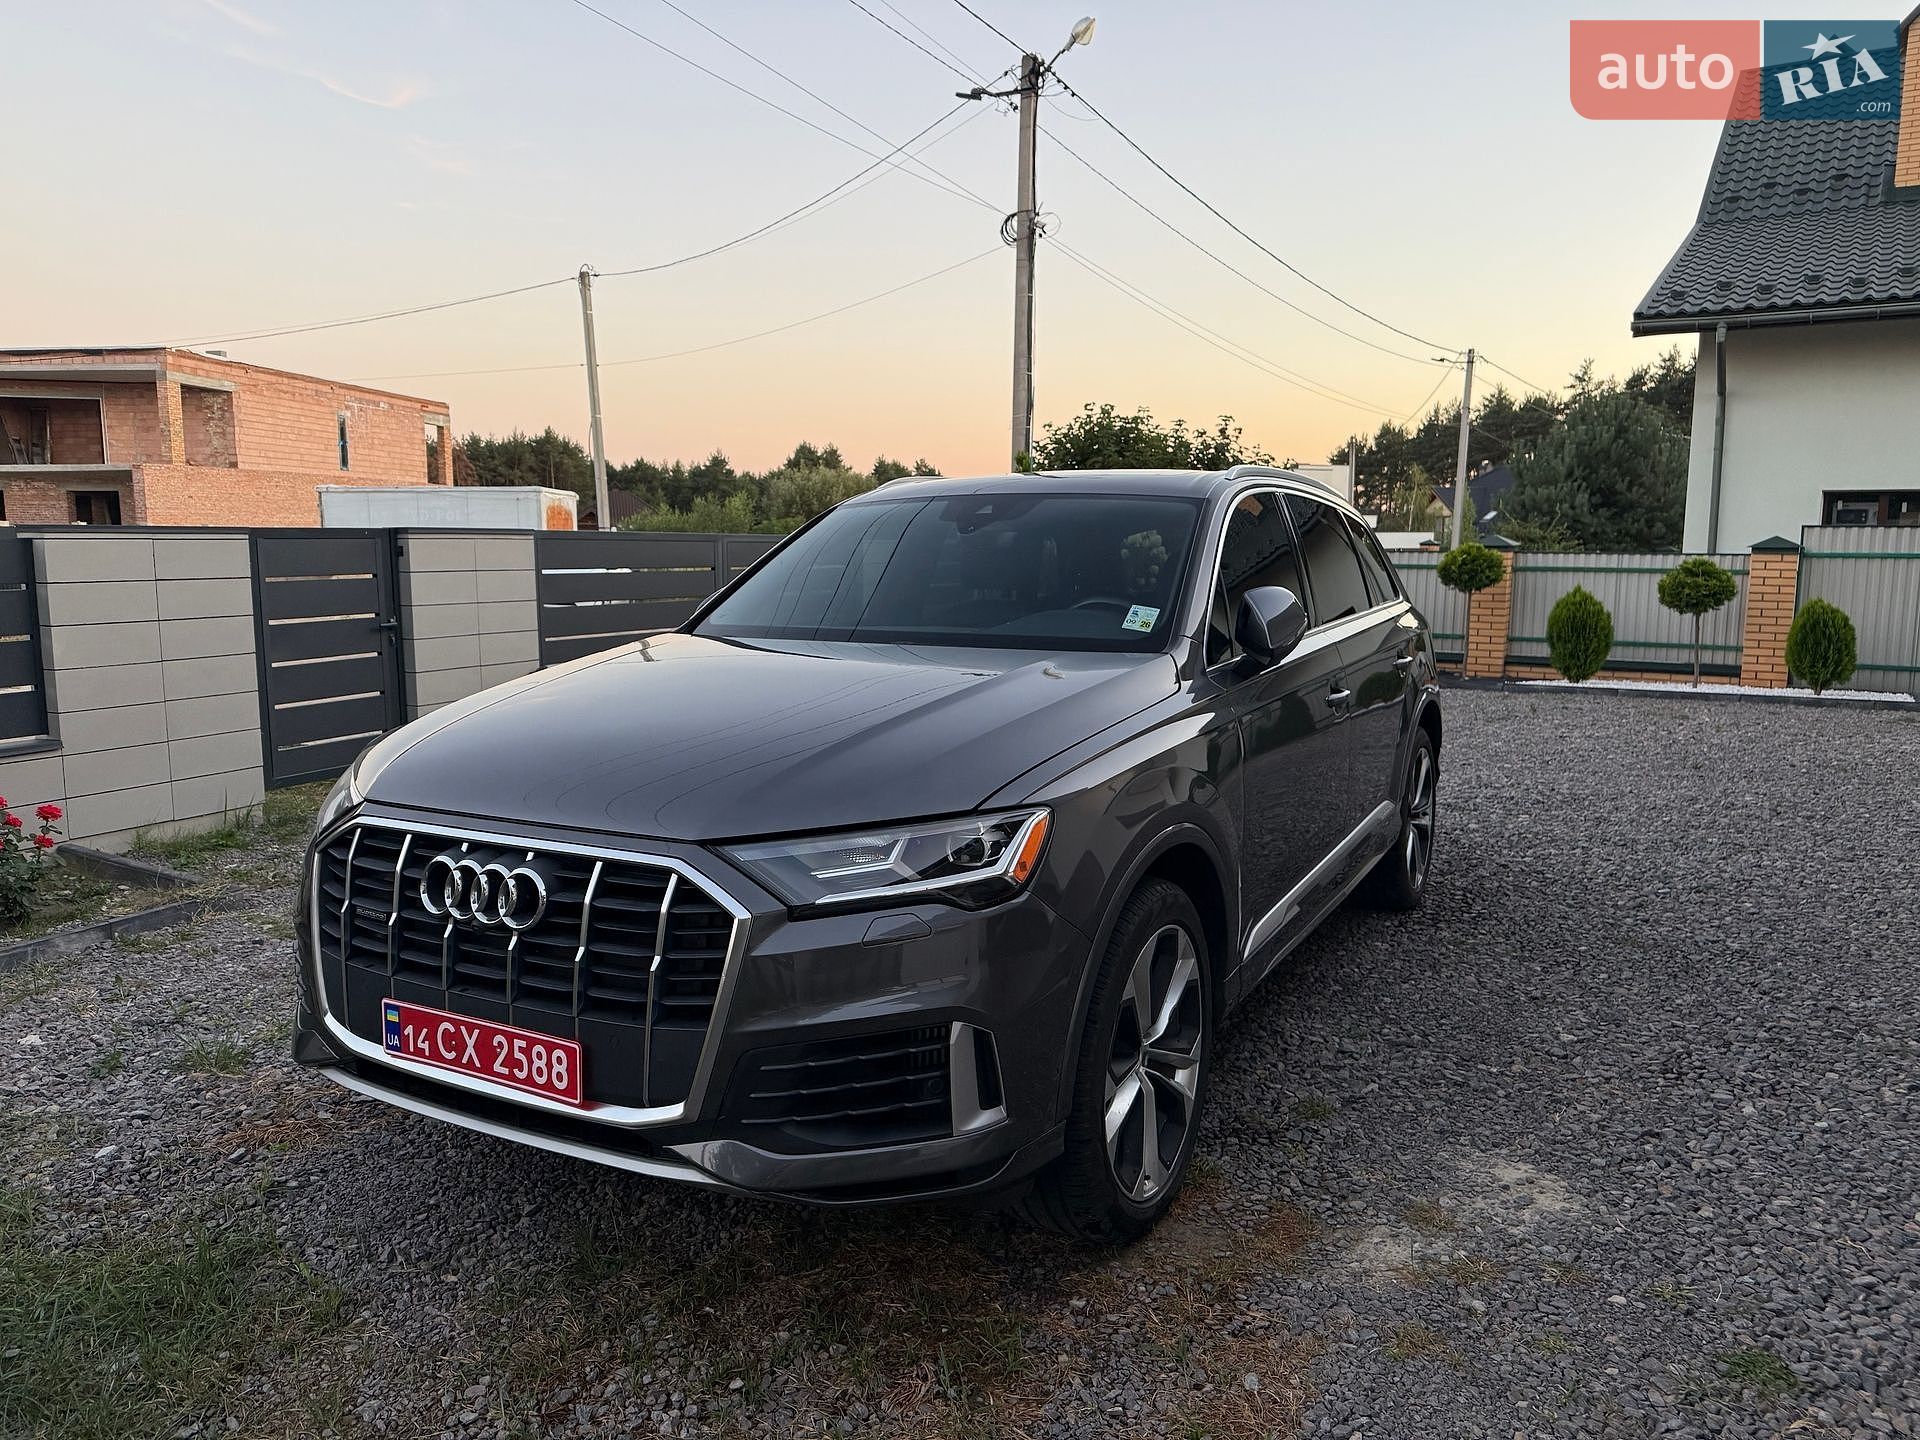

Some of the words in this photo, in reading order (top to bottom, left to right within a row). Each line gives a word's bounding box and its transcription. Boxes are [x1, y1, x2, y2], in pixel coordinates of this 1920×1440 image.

[1140, 620, 1151, 628] 26
[387, 1033, 400, 1048] UA
[403, 1024, 430, 1056] 14
[436, 1021, 481, 1068] CX
[493, 1034, 569, 1090] 2588
